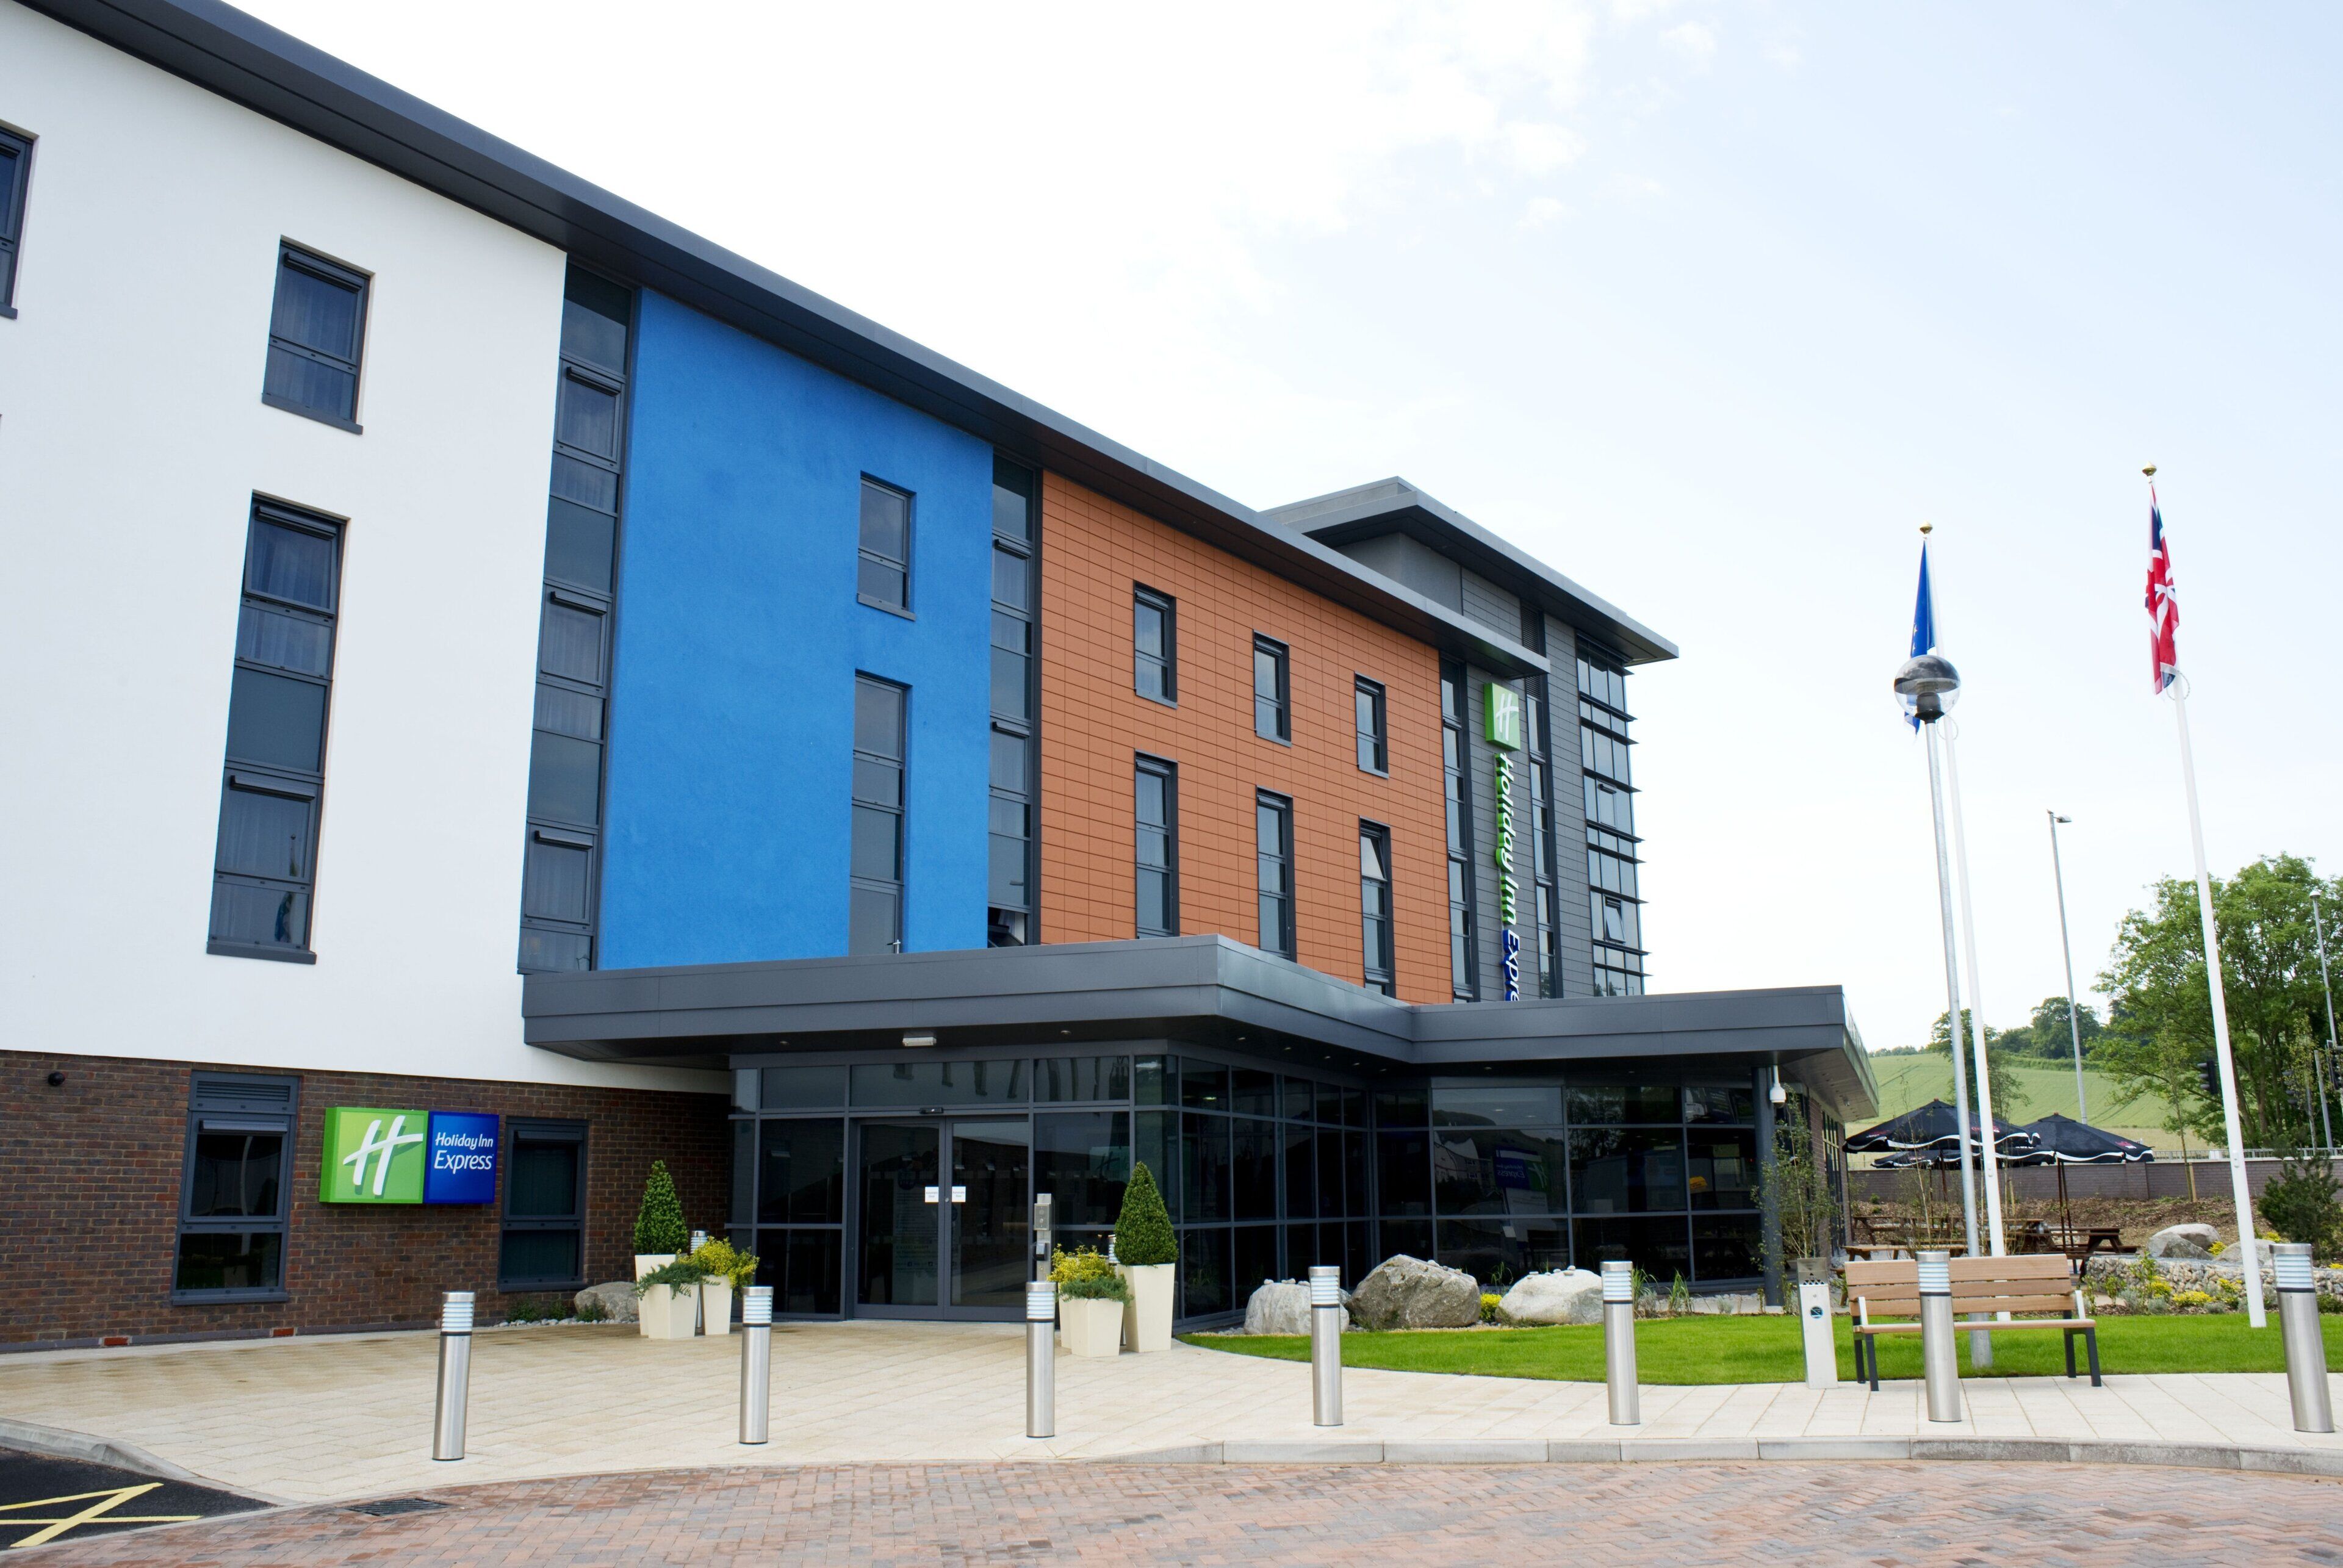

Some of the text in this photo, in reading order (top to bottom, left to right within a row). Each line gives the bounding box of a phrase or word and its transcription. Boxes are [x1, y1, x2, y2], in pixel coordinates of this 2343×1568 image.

[1499, 752, 1521, 1001] Holiday Inn Expre
[435, 1132, 494, 1150] Holiday Inn
[434, 1149, 493, 1174] Express
